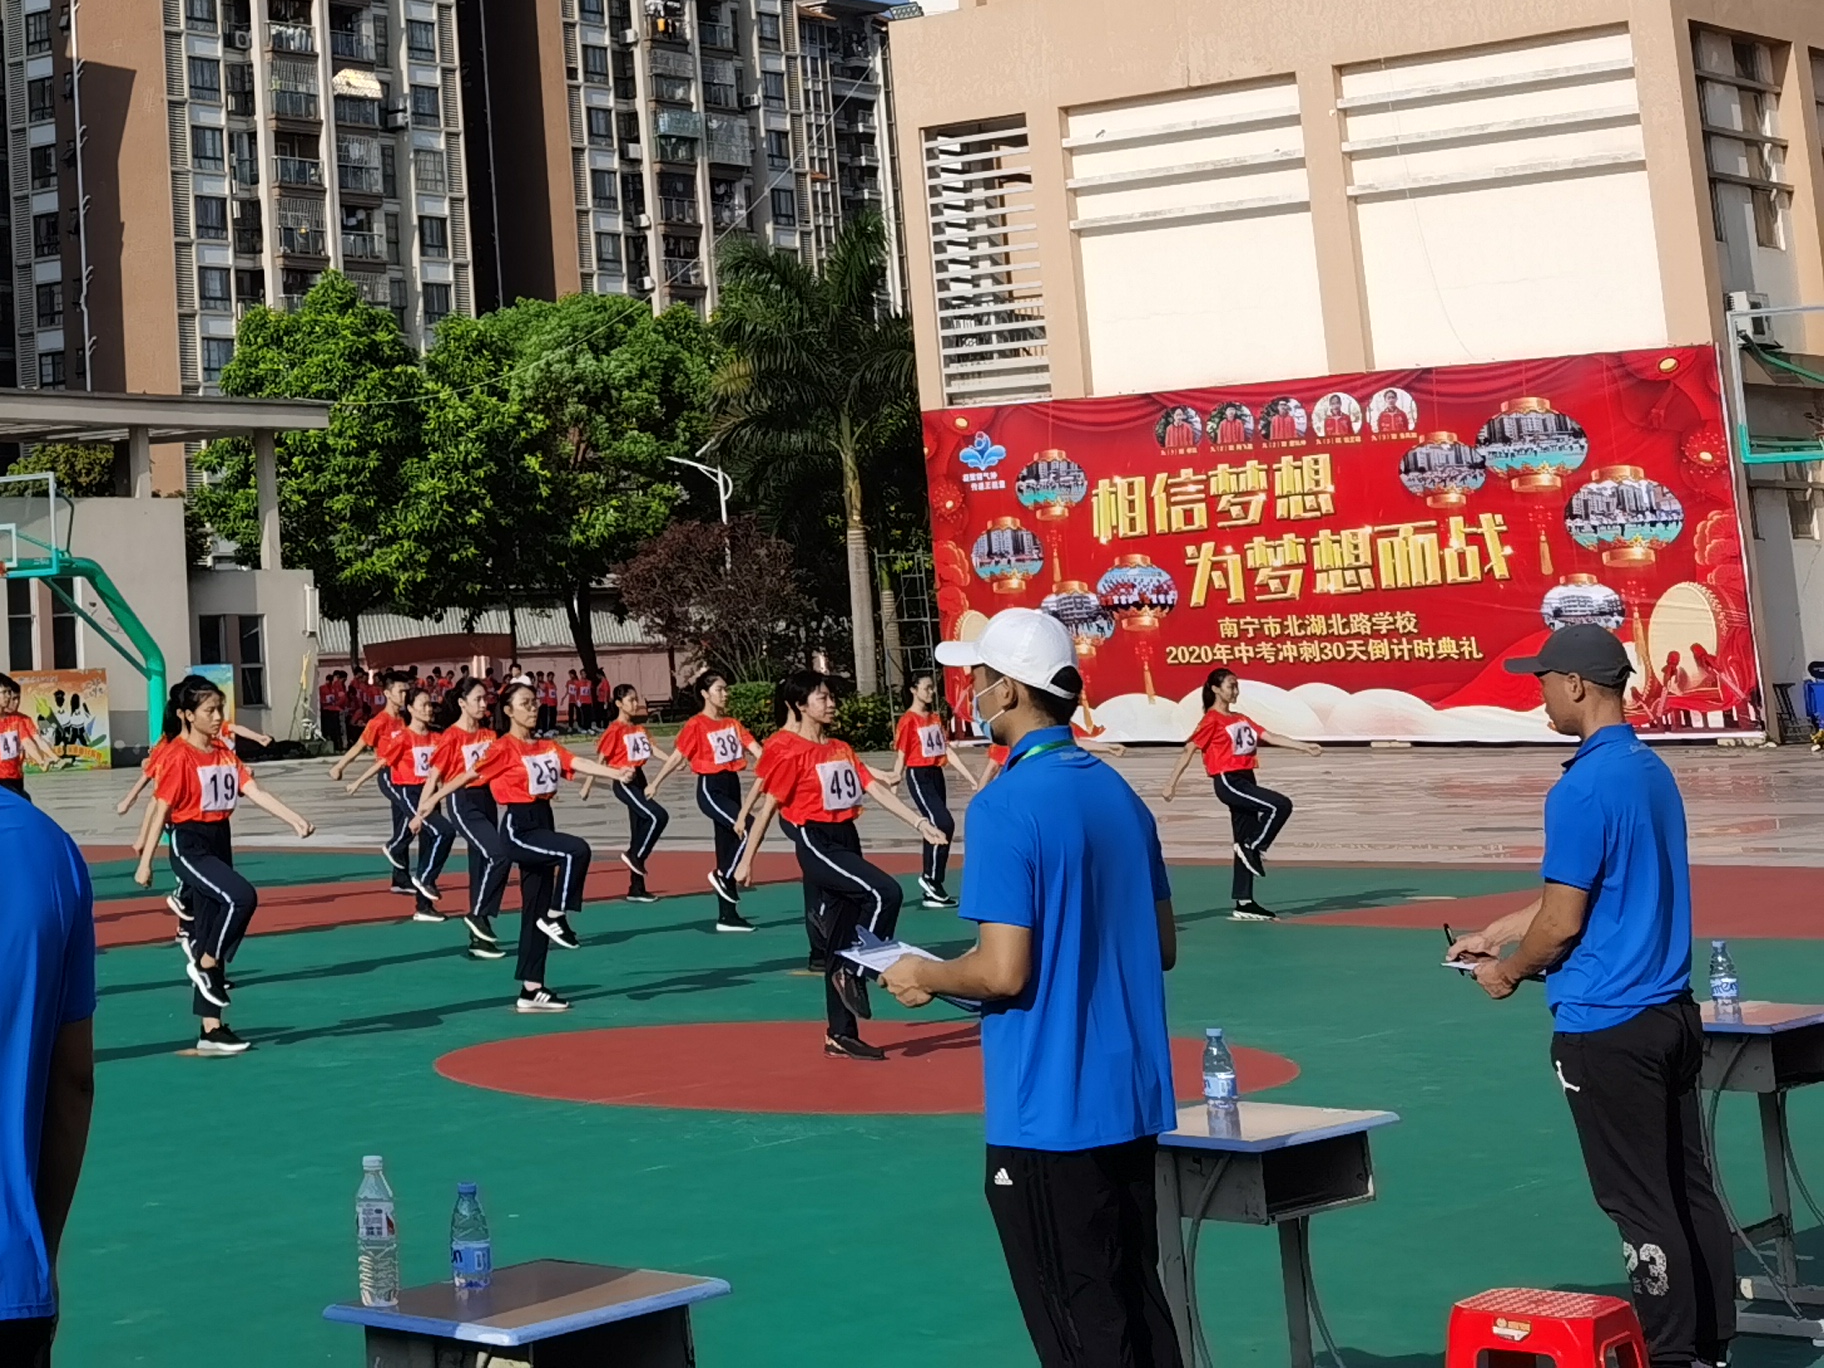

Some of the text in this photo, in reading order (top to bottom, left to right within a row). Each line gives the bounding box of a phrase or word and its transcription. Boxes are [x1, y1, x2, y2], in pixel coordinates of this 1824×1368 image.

[1092, 453, 1335, 541] 相信梦想
[1185, 513, 1514, 608] 为梦想而战
[1217, 611, 1418, 638] 南宁市北湖北路学校
[1166, 636, 1484, 665] 2020年中考冲刺30天倒计时典礼
[632, 736, 651, 753] 45
[717, 733, 738, 756] 38
[927, 731, 943, 750] 44
[1236, 726, 1255, 748] 43
[532, 759, 558, 785] 25
[830, 769, 856, 800] 49
[210, 773, 235, 803] 19
